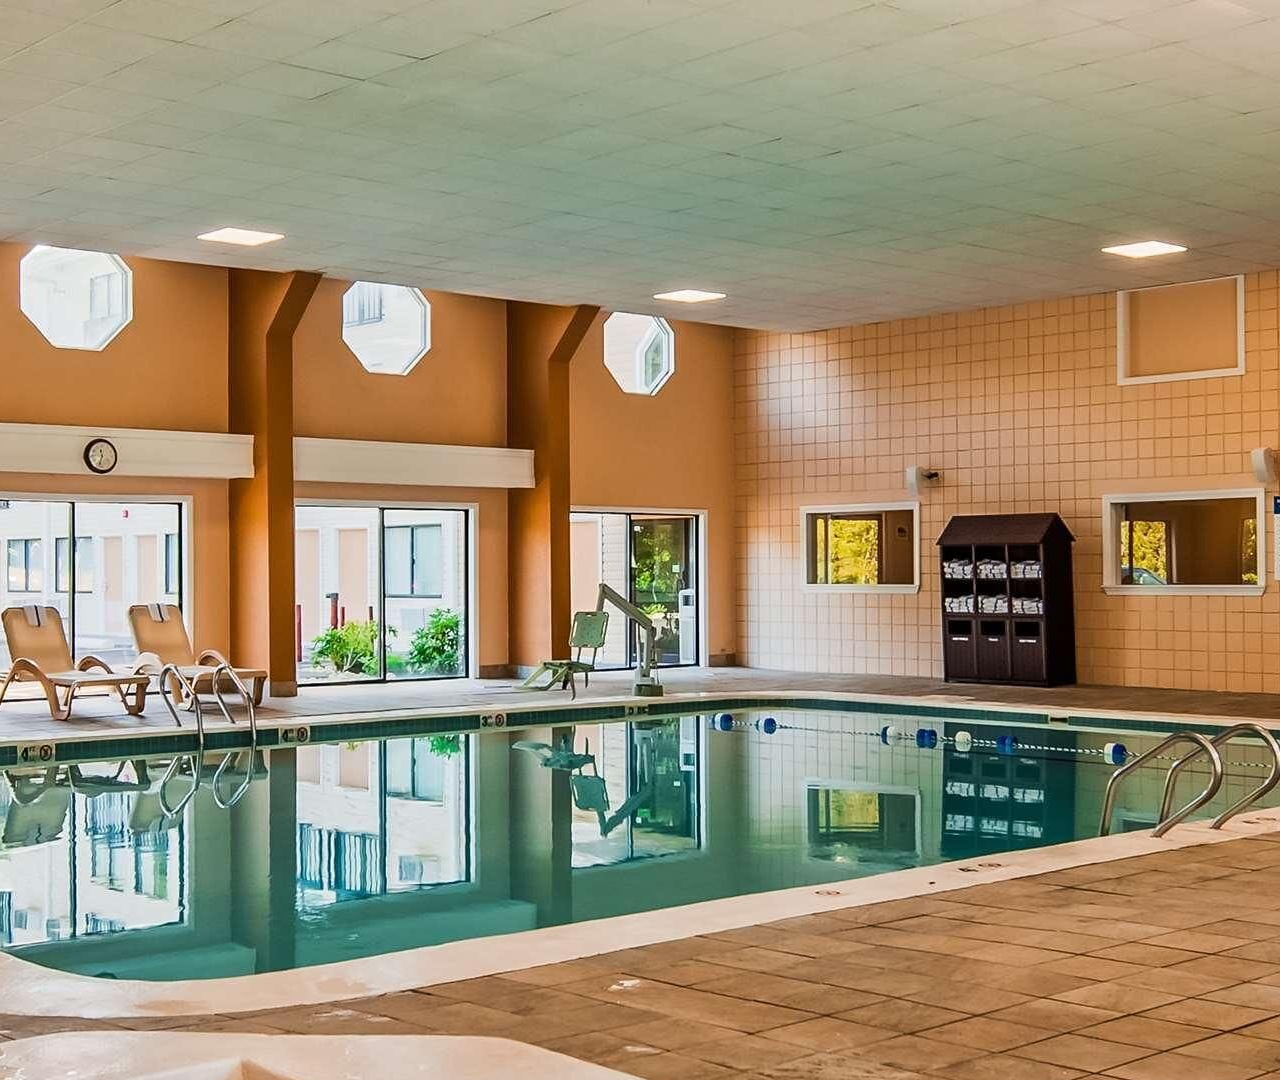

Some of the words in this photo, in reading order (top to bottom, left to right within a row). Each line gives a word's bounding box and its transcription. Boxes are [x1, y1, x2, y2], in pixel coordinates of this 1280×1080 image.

[481, 715, 488, 727] 3
[282, 728, 289, 742] 4
[22, 747, 28, 761] 4
